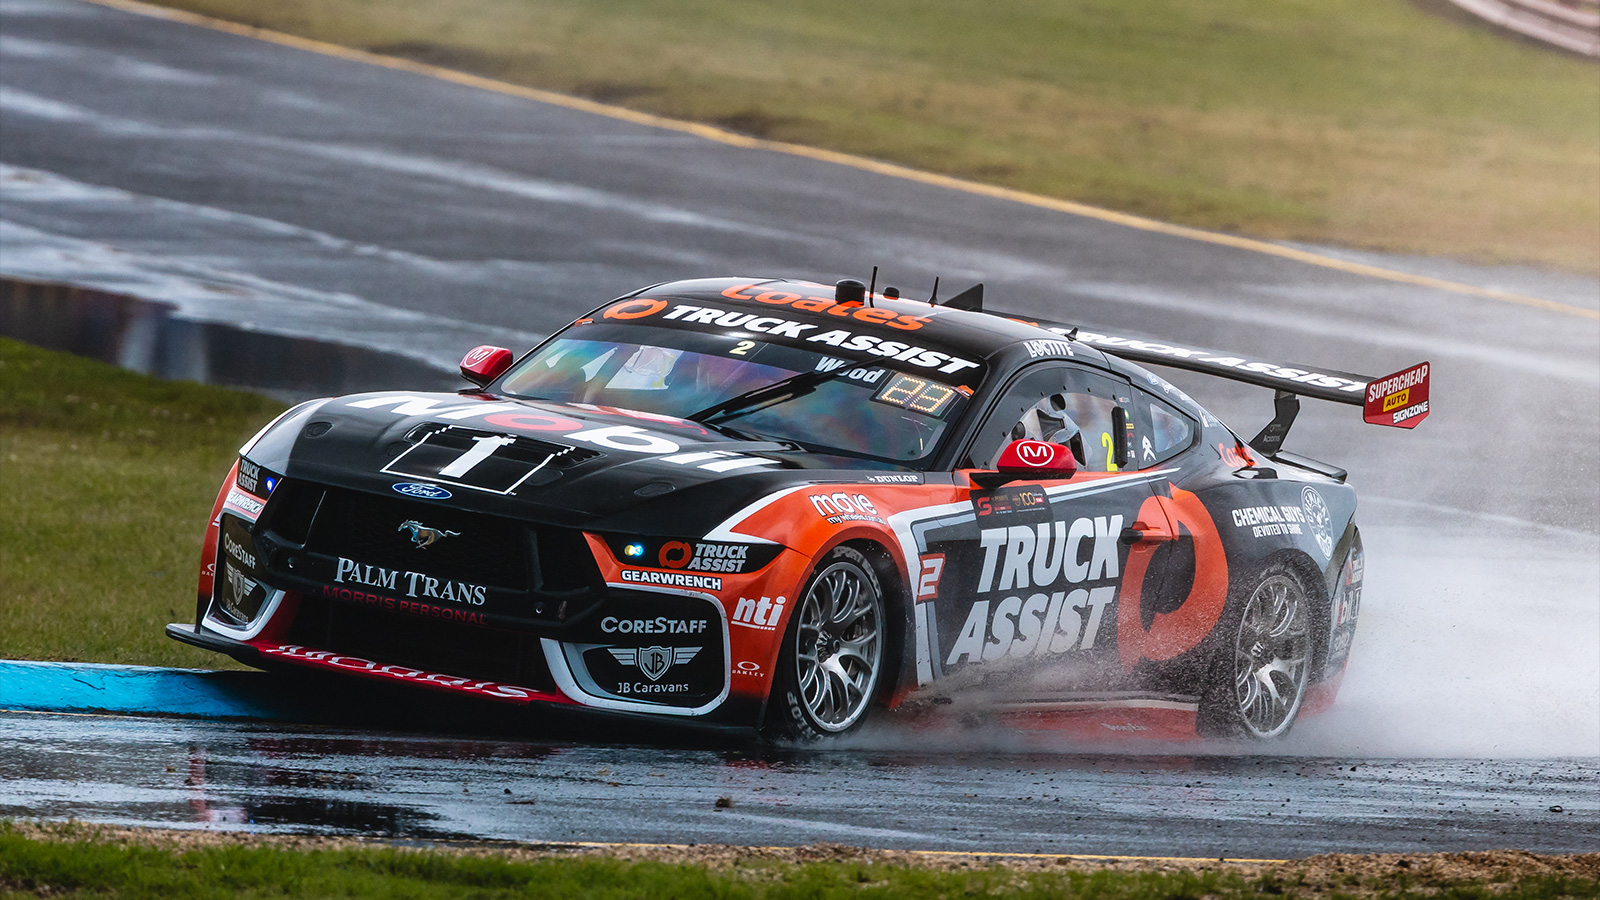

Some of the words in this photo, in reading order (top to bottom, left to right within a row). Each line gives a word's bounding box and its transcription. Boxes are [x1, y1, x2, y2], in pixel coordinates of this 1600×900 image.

[721, 284, 933, 331] Coates
[662, 305, 819, 339] TRUCK
[806, 329, 980, 374] ASSIST
[729, 341, 756, 355] 2
[1023, 340, 1074, 358] LOCTITE
[815, 356, 886, 383] Wod
[1198, 356, 1367, 392] ASSIST
[881, 376, 954, 413] 23
[1368, 364, 1428, 403] SUPERCHEAP
[1385, 394, 1407, 408] AUTO
[1392, 401, 1428, 424] SIGNZONE
[345, 397, 782, 473] Mobil
[439, 434, 517, 478] 1
[1022, 446, 1048, 457] M
[1101, 432, 1118, 471] 2
[241, 459, 260, 480] TRUCK
[238, 473, 257, 492] ASSIST
[401, 483, 444, 498] Ford
[808, 491, 878, 517] move
[1231, 506, 1284, 527] CHEMICAL
[1281, 505, 1306, 524] GUYS
[1252, 524, 1281, 538] DEVOTED
[695, 543, 749, 559] TRUCK
[977, 514, 1124, 593] TRUCK
[687, 557, 746, 573] ASSIST
[621, 570, 722, 590] GEARWRENCH
[919, 557, 944, 597] 2
[323, 585, 396, 610] MORRIS
[400, 600, 489, 625] PERSONAL
[732, 596, 786, 627] nti
[946, 586, 1116, 665] ASSIST
[644, 652, 665, 675] JB
[732, 670, 765, 678] OAKLEY
[616, 682, 631, 694] JB
[633, 682, 689, 693] Caravans
